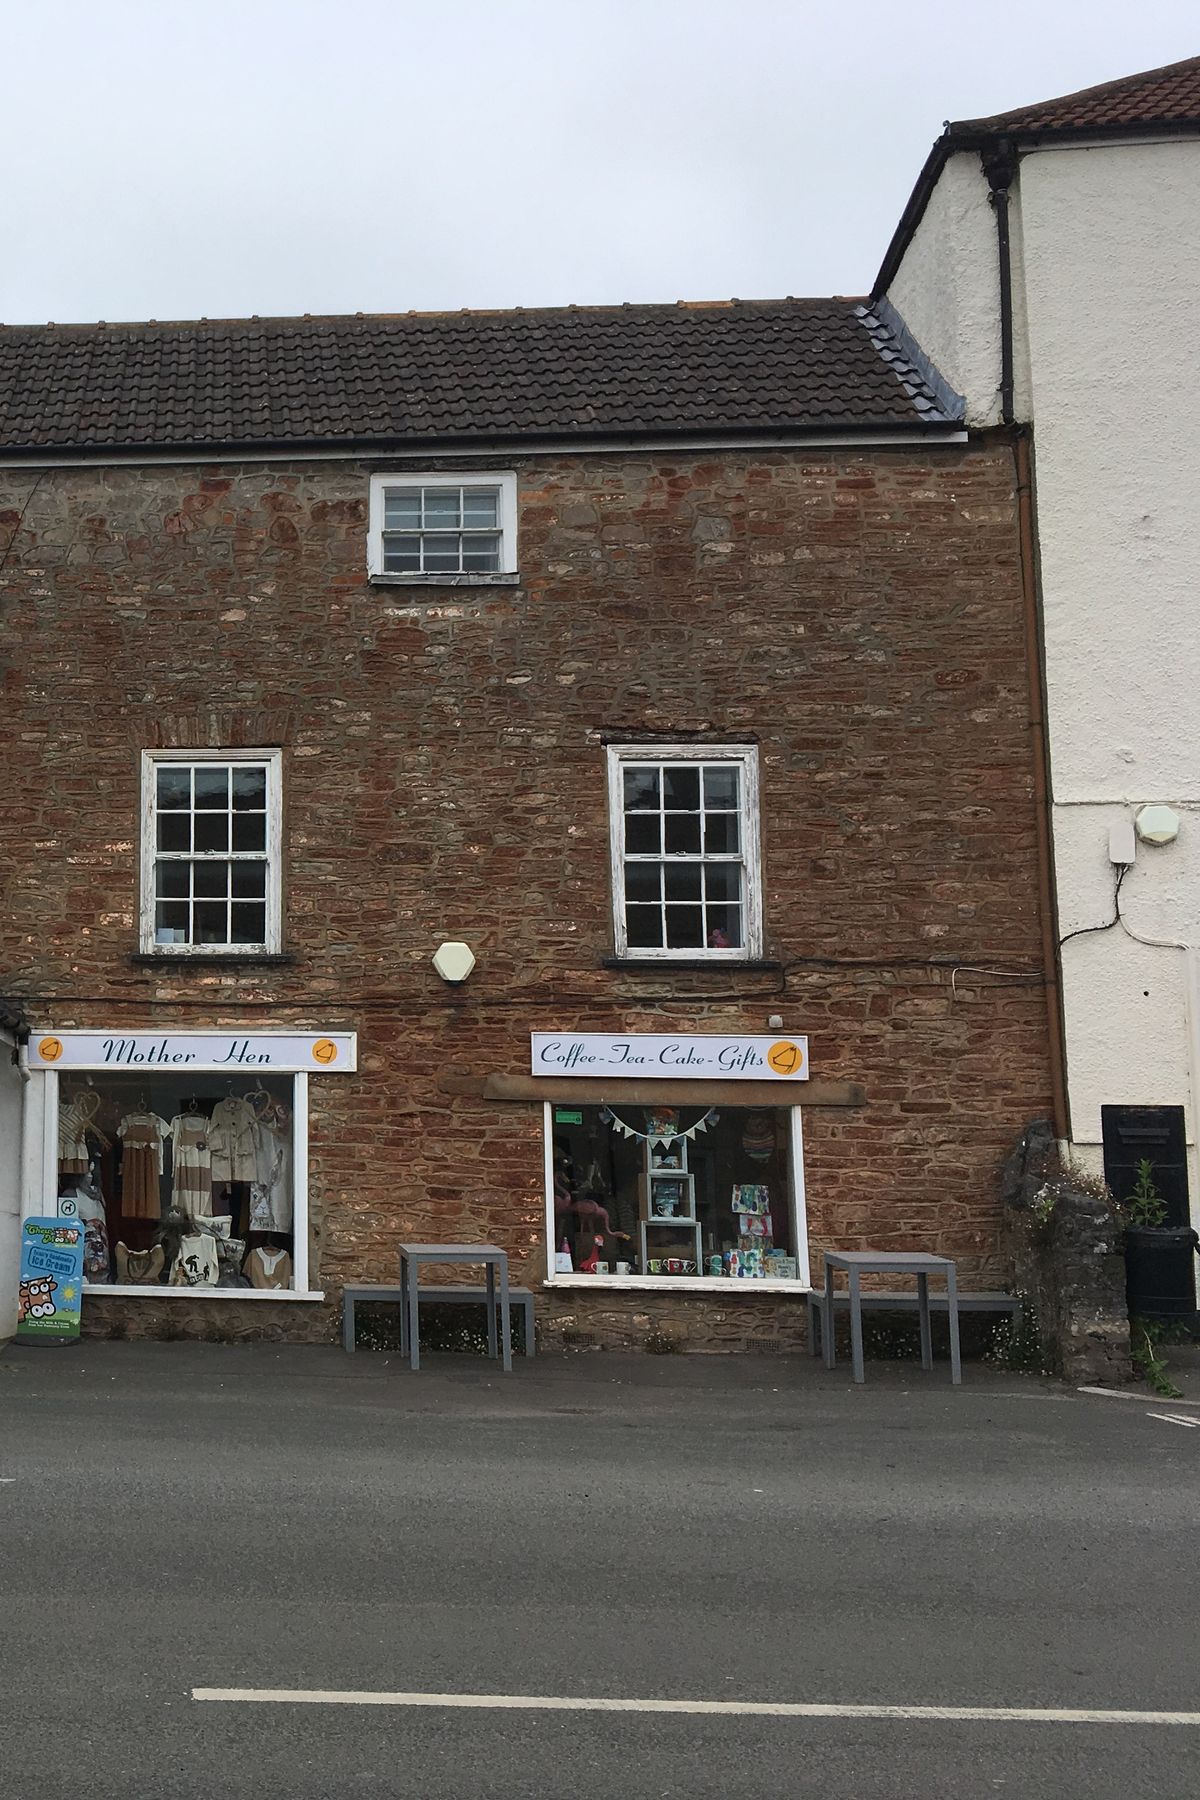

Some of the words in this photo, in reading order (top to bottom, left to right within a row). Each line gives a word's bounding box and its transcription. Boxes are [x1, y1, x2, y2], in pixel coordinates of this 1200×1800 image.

[102, 1039, 196, 1064] Mother
[213, 1040, 272, 1063] Hen
[540, 1041, 597, 1068] Coffee
[608, 1044, 645, 1064] Tea
[659, 1043, 705, 1065] Cake
[717, 1046, 763, 1071] Gifts
[31, 1256, 44, 1266] Ice
[45, 1258, 71, 1273] Cream
